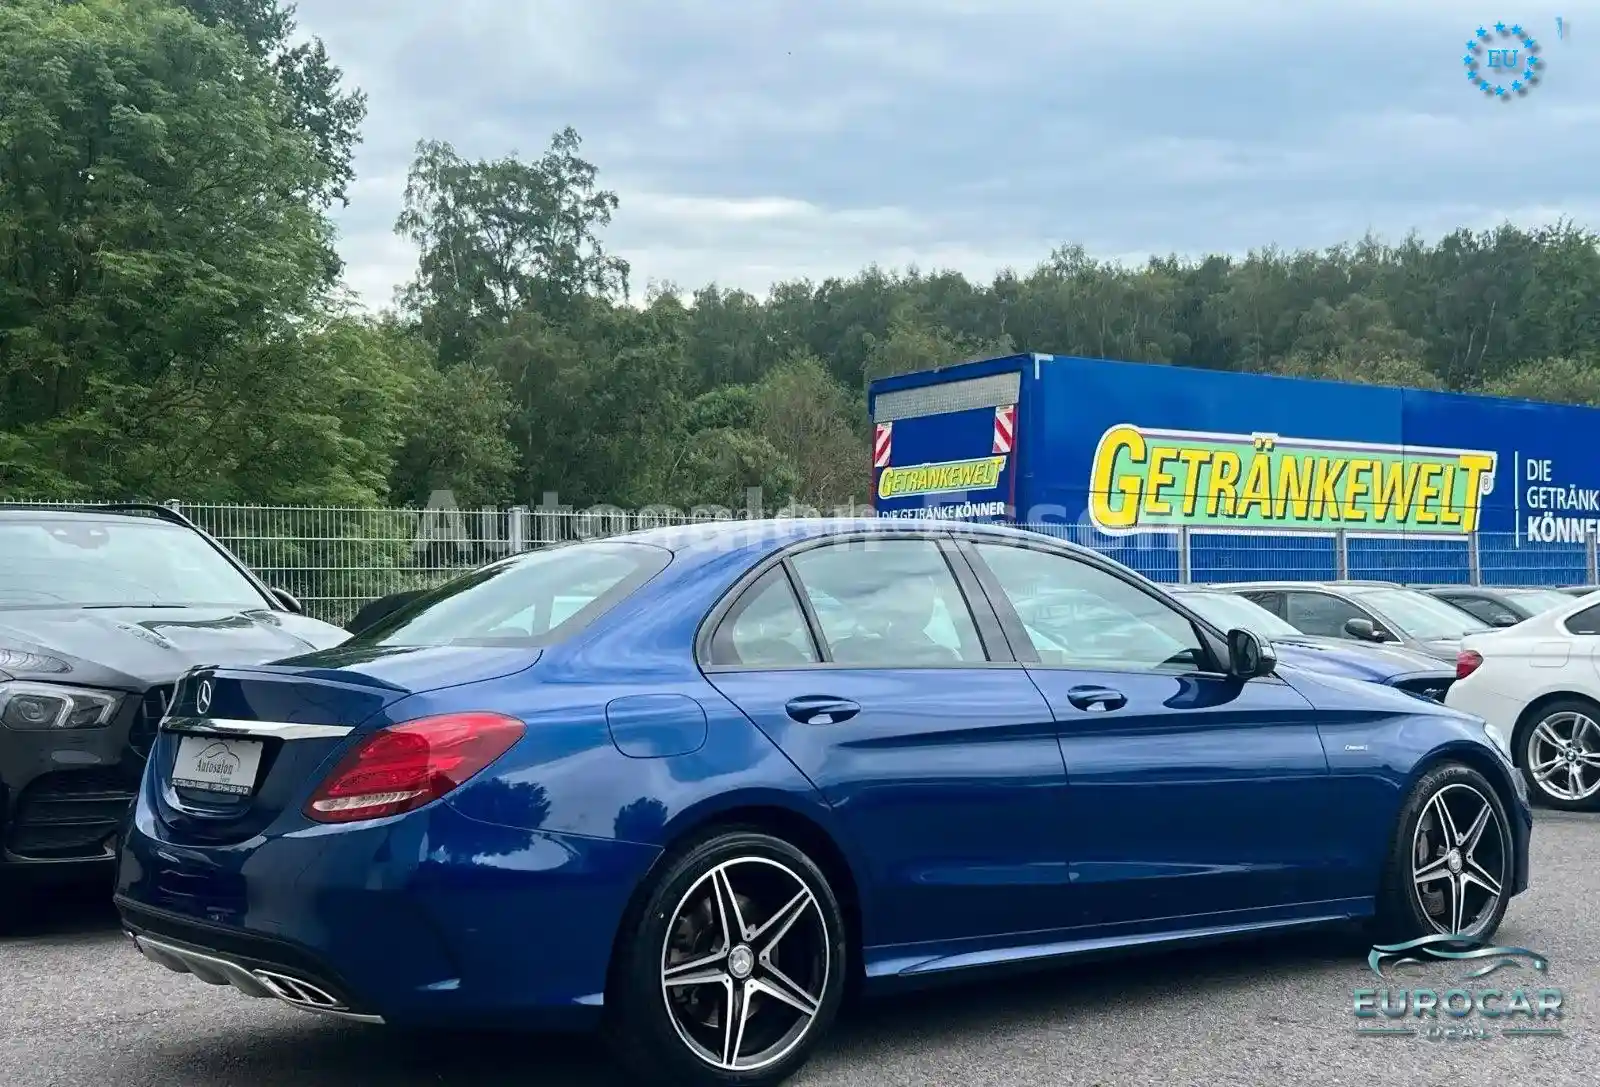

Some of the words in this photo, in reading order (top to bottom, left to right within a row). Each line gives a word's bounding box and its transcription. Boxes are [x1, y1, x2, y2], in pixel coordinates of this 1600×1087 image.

[880, 457, 1003, 497] GETRÄNKEWELT
[1092, 427, 1493, 534] GETRÄNKEWELT
[1527, 458, 1552, 482] DIE
[955, 501, 1005, 518] KÖNNER
[1527, 511, 1600, 544] KÖNNE
